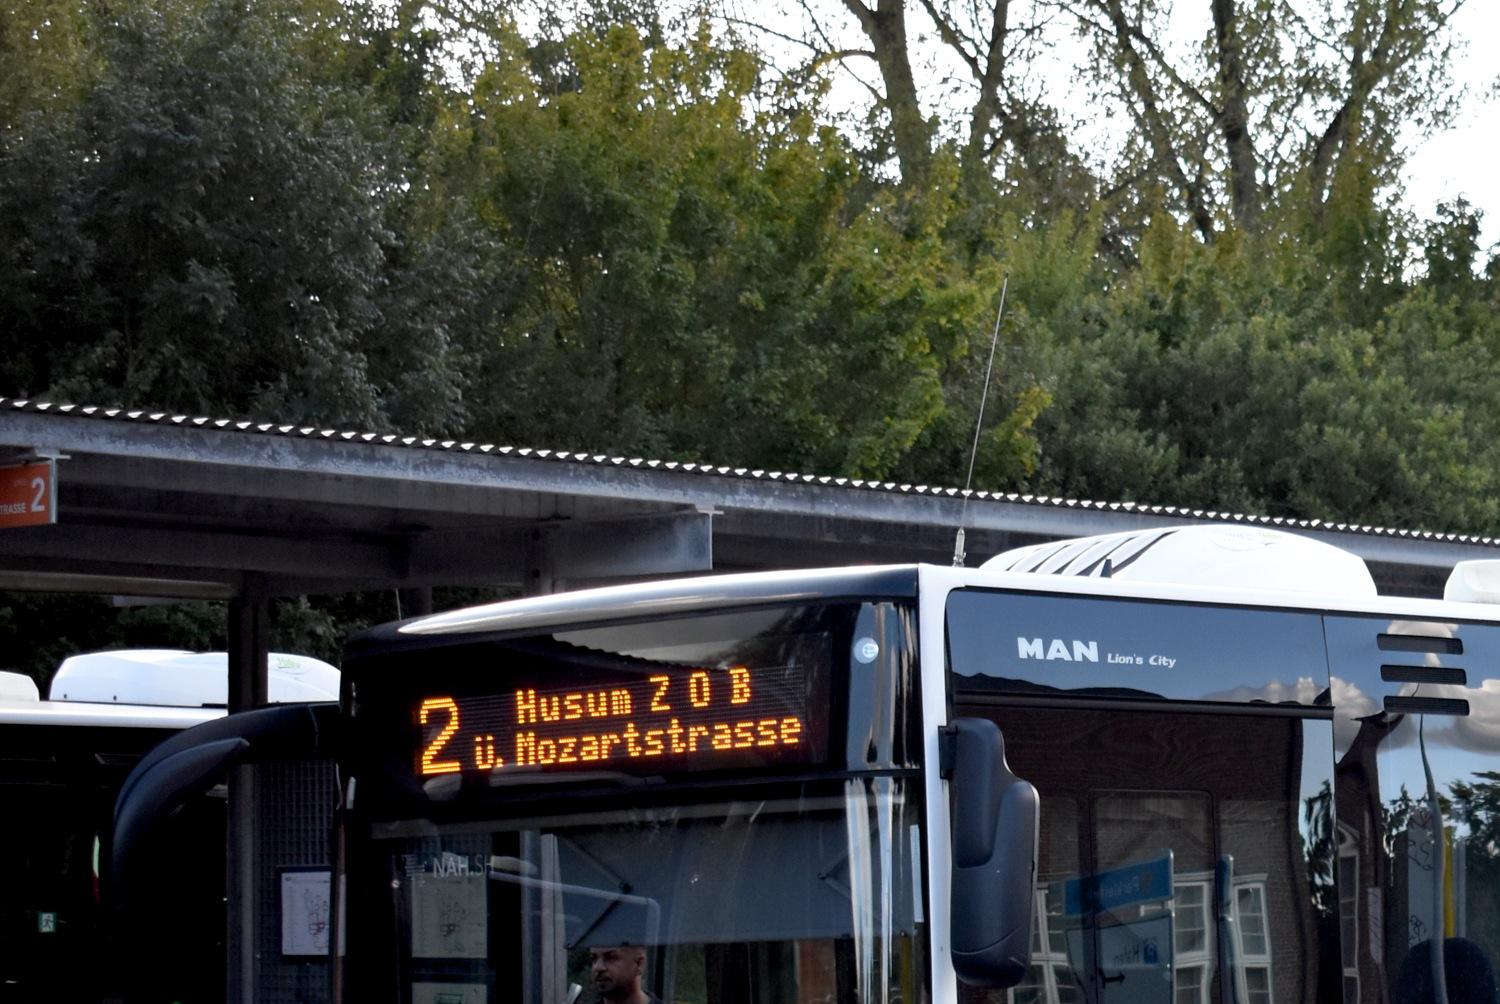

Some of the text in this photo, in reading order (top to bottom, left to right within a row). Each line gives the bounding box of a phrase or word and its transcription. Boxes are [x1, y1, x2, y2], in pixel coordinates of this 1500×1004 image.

[31, 477, 45, 512] 2
[1017, 636, 1176, 668] MAN Lion's City
[516, 689, 632, 724] Husum
[420, 697, 460, 775] 2
[433, 854, 494, 878] NAH.SH
